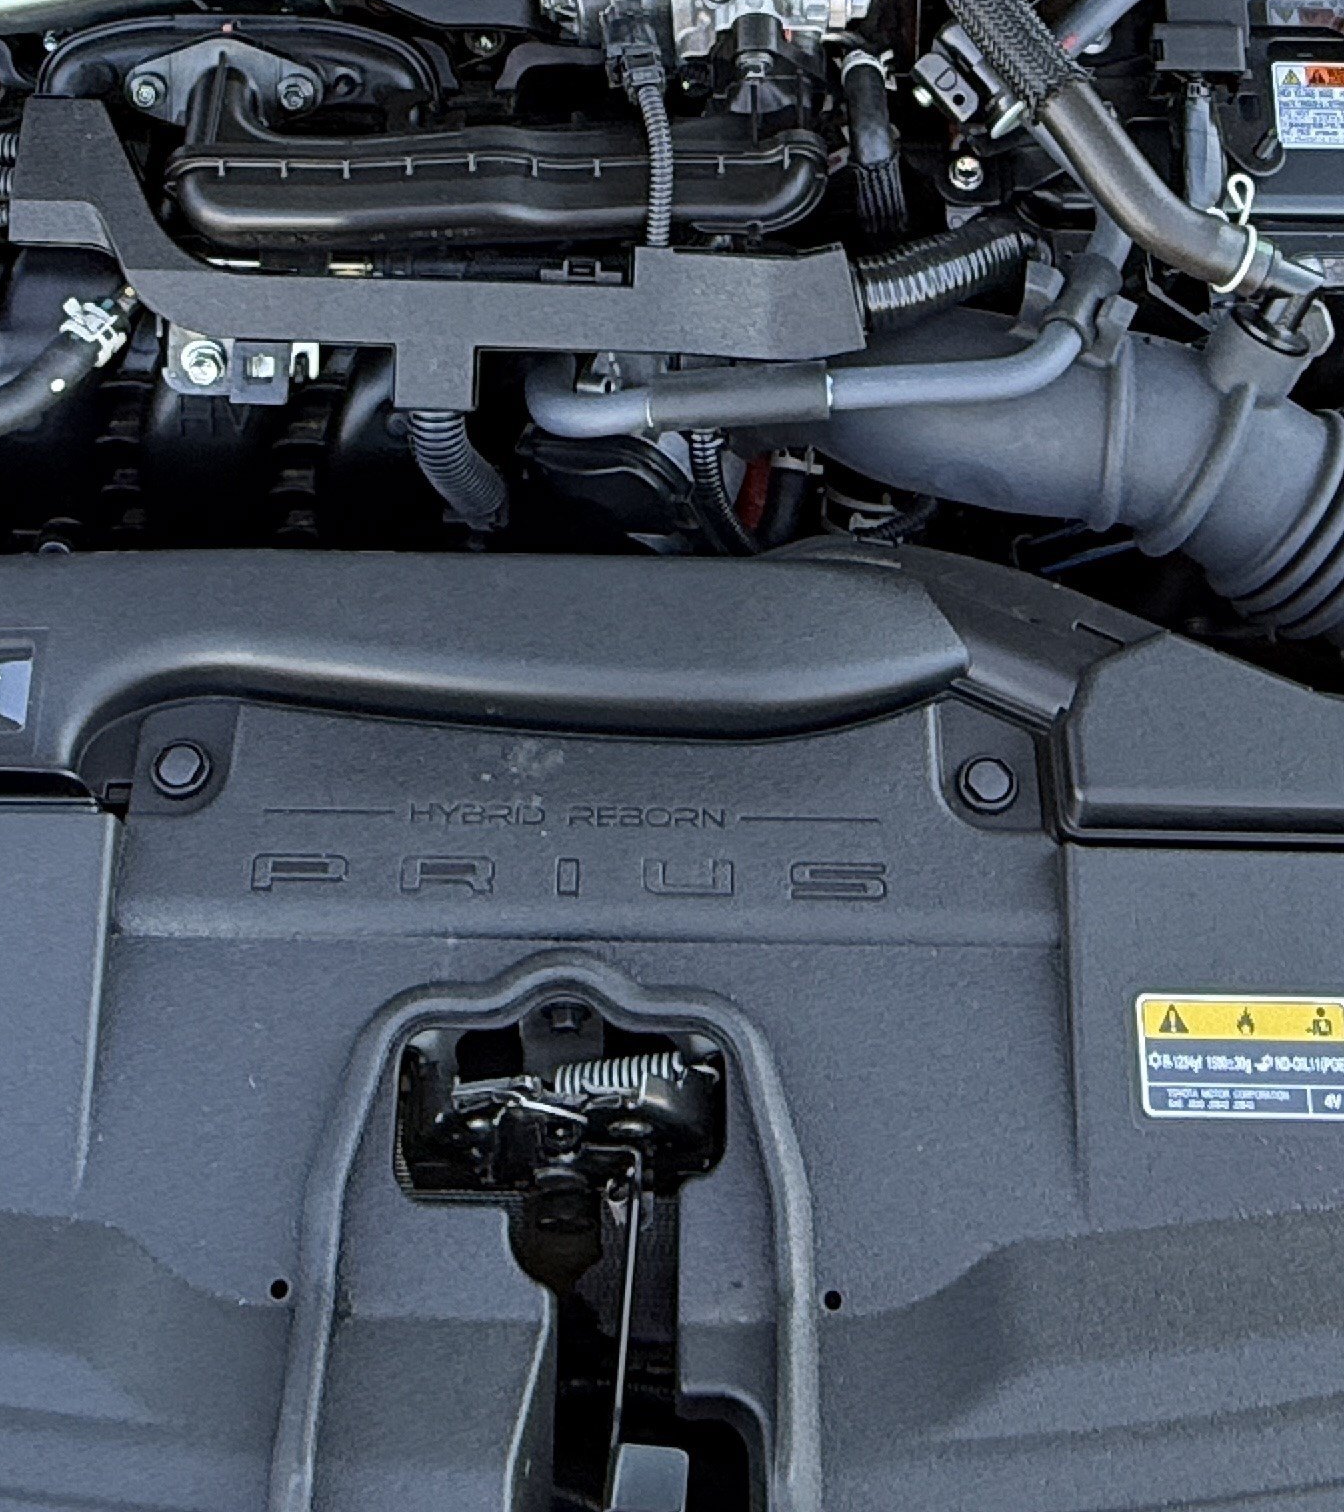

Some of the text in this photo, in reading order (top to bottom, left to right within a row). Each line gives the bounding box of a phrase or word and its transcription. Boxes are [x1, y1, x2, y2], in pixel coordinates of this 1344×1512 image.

[410, 802, 726, 830] HYBRID REBORN
[249, 851, 890, 901] PRIUS
